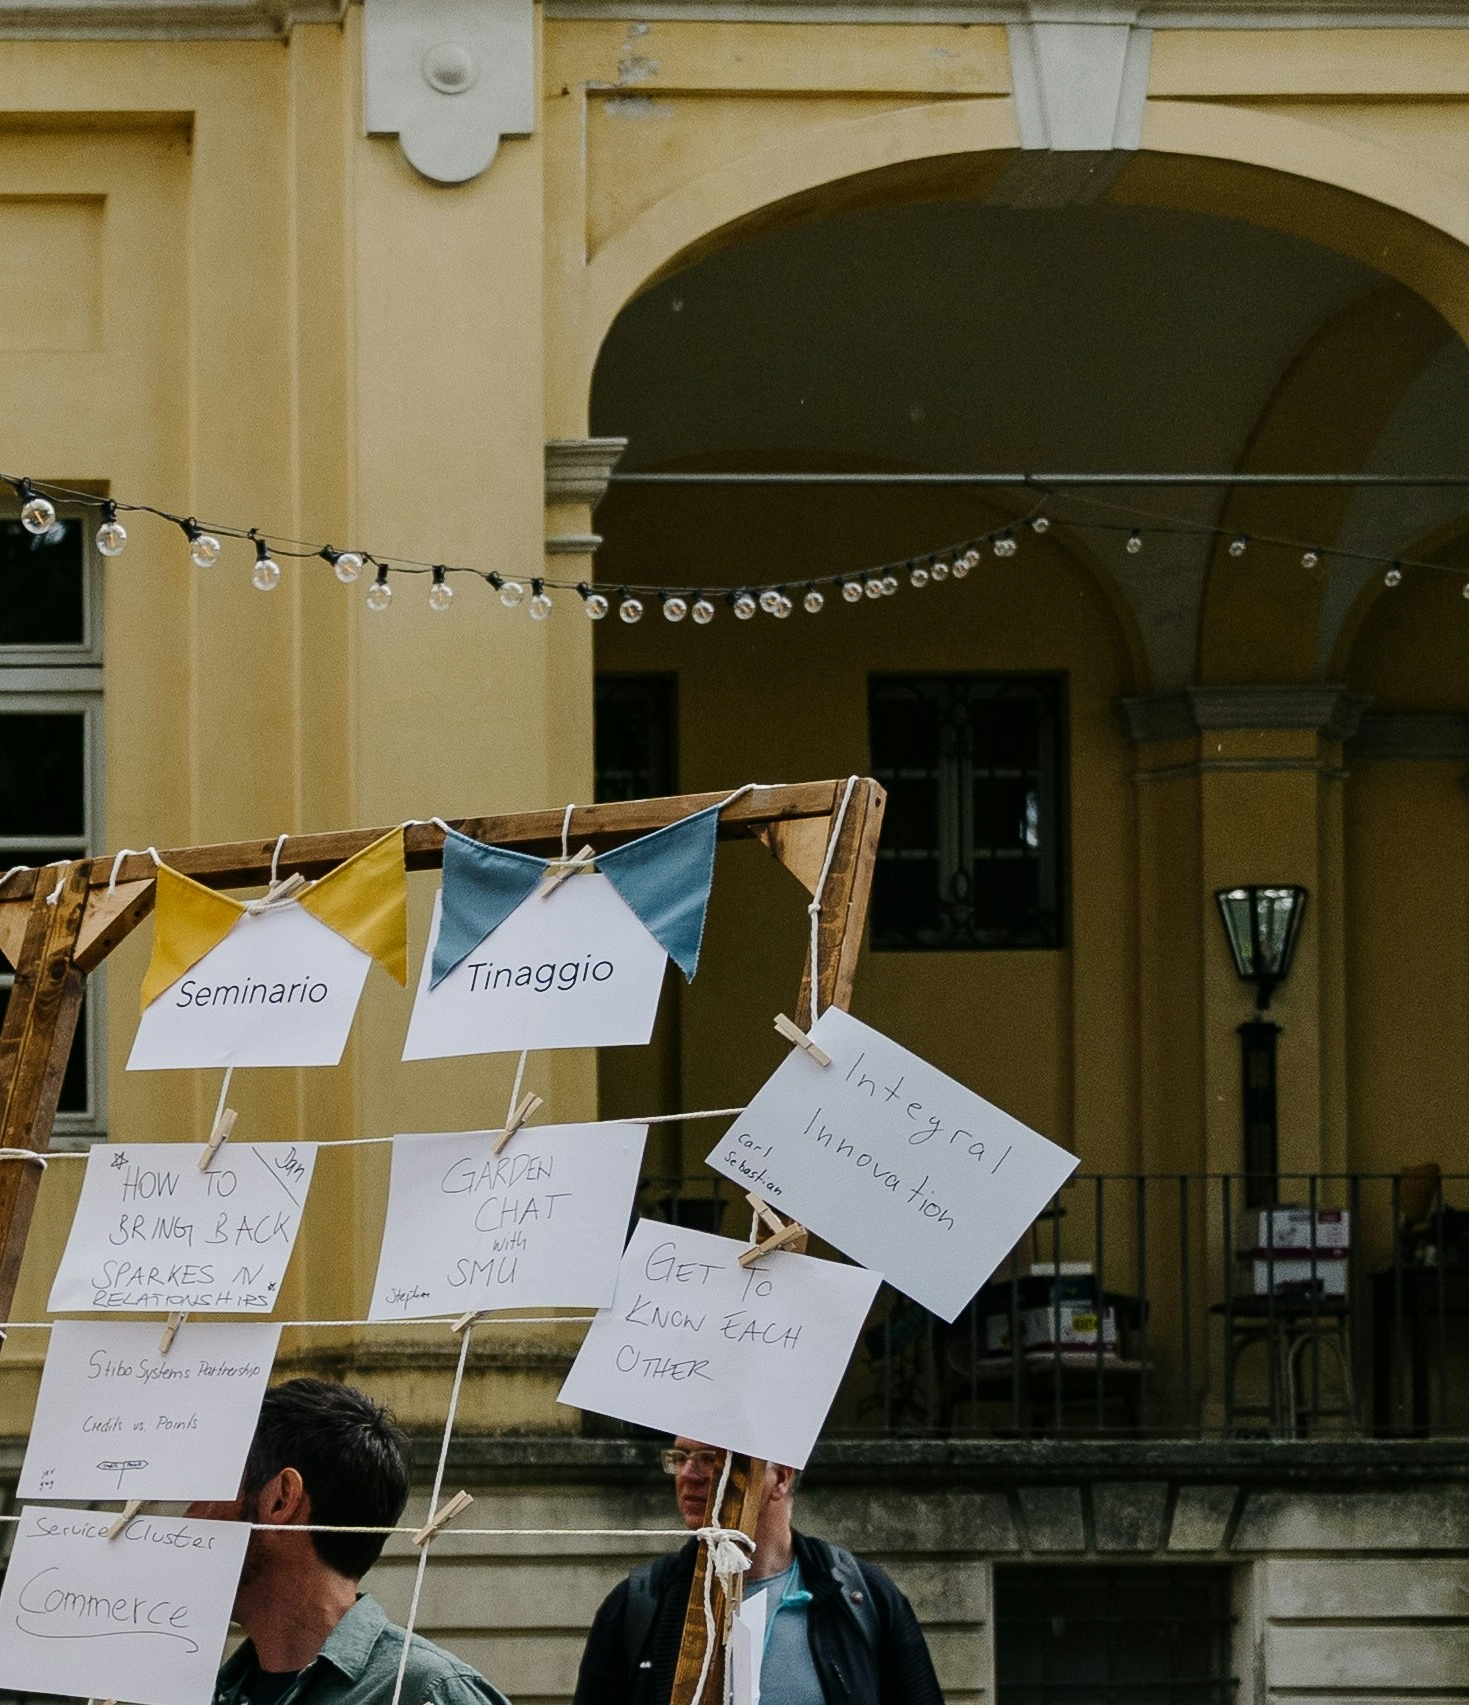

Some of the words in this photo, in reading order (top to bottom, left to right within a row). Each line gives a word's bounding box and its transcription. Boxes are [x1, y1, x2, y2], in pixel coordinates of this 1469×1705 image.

[175, 976, 328, 1009] Seminario
[465, 956, 614, 995] Tinaggio
[845, 1053, 1013, 1175] Integral
[737, 1131, 772, 1158] Carl
[122, 1165, 180, 1202] HOW
[204, 1170, 238, 1197] TO
[441, 1153, 554, 1194] GARDEN
[723, 1149, 784, 1198] Sebastian
[803, 1107, 957, 1232] Innovation
[108, 1213, 193, 1247] BRING
[204, 1211, 291, 1246] BACK
[474, 1193, 573, 1233] CHAT
[91, 1259, 215, 1289] SPARKES
[231, 1263, 265, 1285] IN
[447, 1256, 518, 1287] SMU
[86, 1349, 133, 1380] Stibo
[135, 1358, 190, 1385] Systems
[196, 1360, 261, 1379] Partnership
[155, 1412, 199, 1431] Points
[26, 1516, 111, 1538] Service
[124, 1519, 216, 1550] Cluster
[18, 1566, 189, 1628] Commerce
